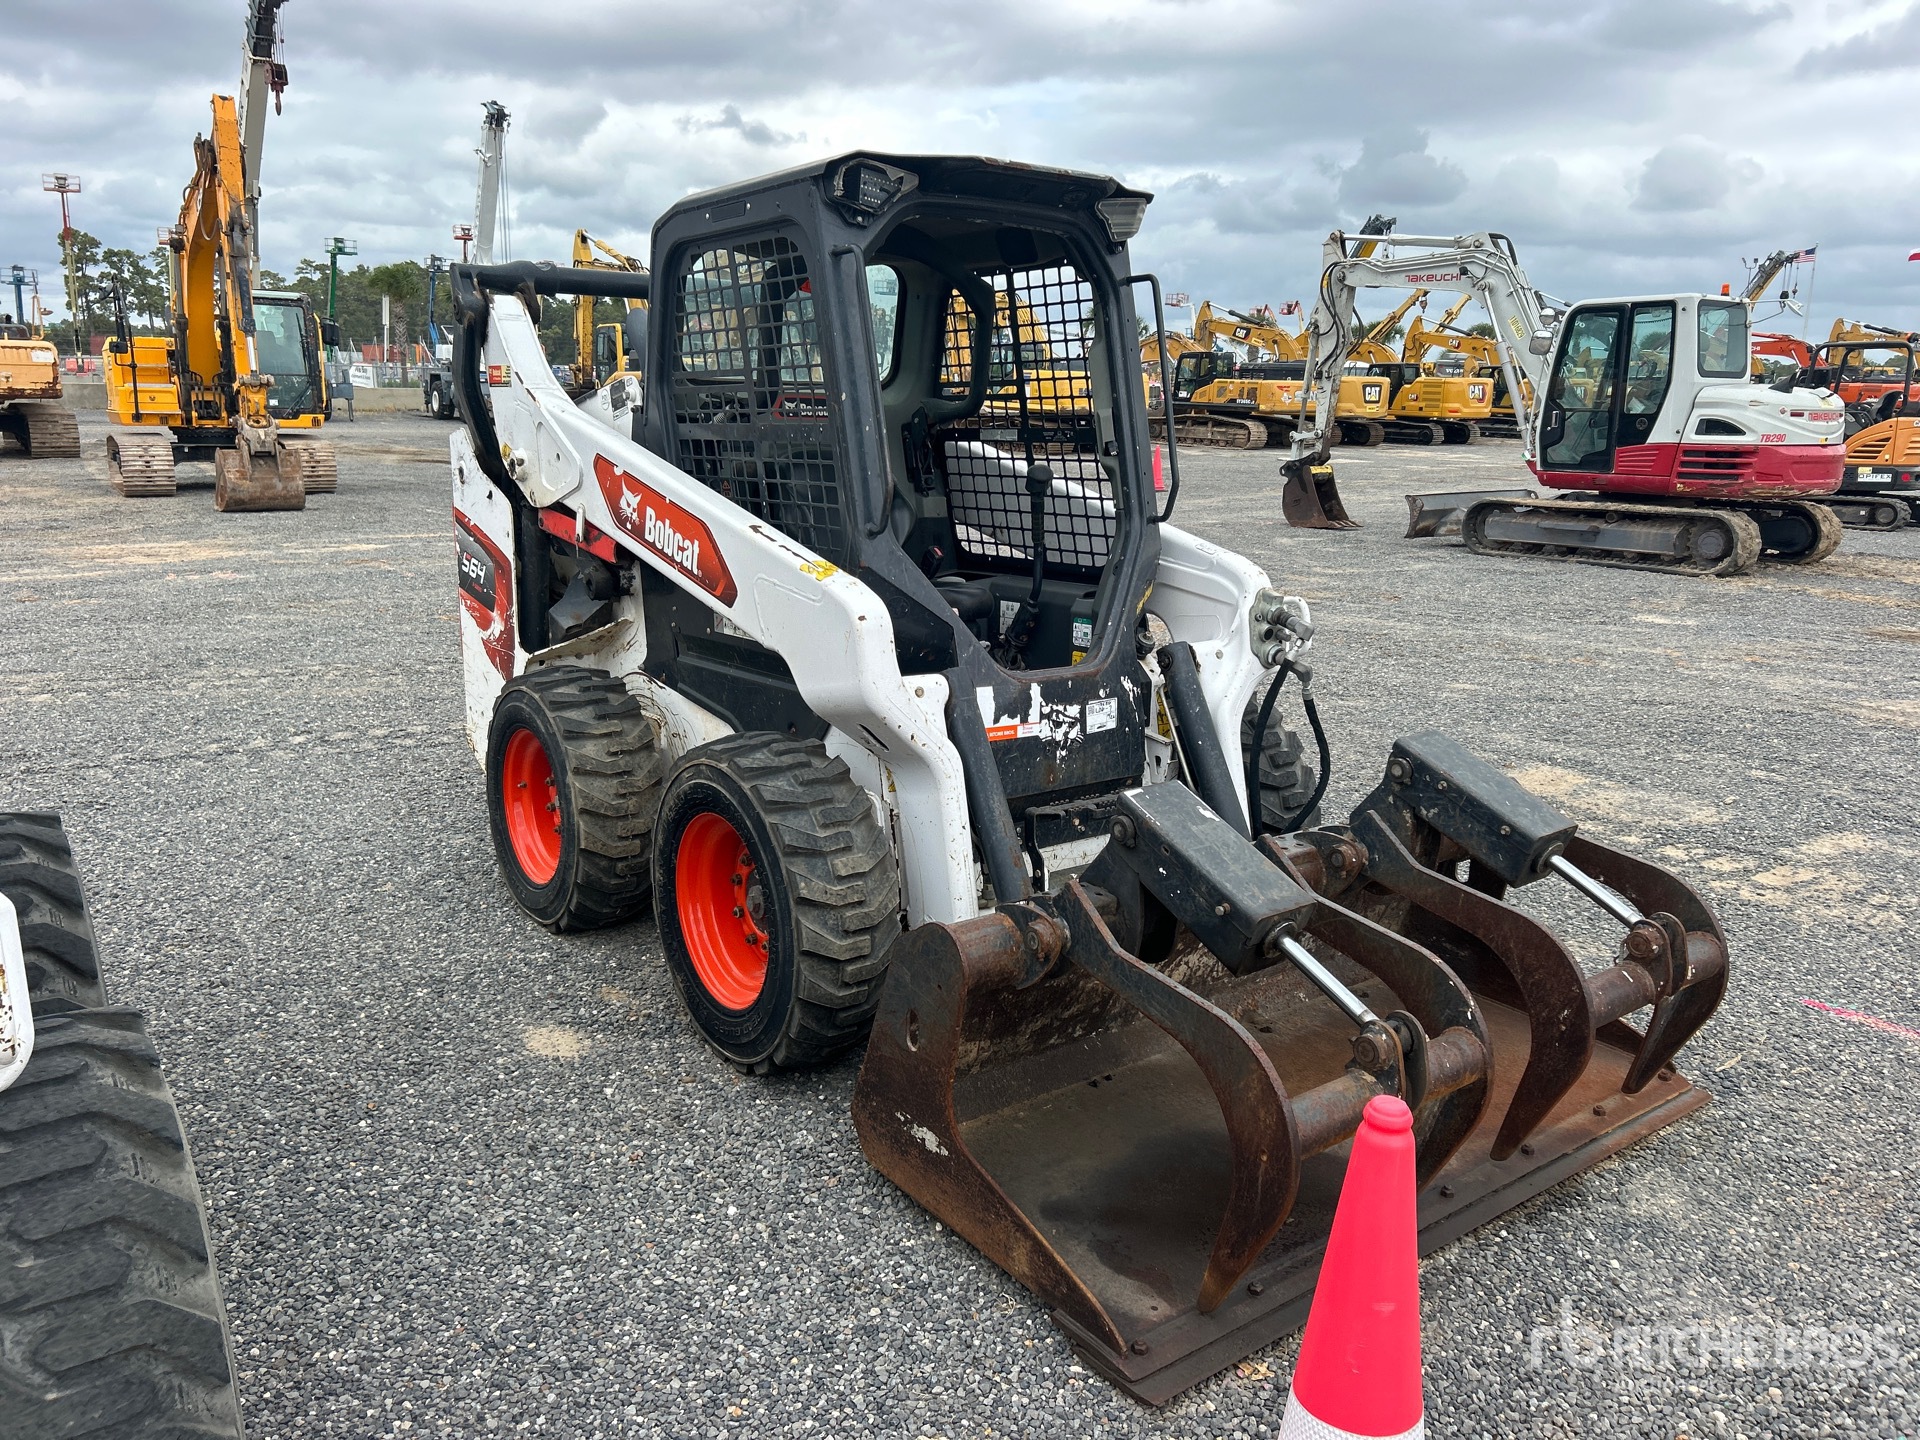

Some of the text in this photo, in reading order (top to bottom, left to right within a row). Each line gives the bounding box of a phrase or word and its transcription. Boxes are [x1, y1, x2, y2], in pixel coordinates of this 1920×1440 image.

[1235, 327, 1247, 339] CAT
[1449, 339, 1460, 348] CAT
[1366, 387, 1380, 401] CAT
[1470, 385, 1483, 400] CAT
[1760, 434, 1787, 443] TB290
[645, 505, 700, 576] Bobcat
